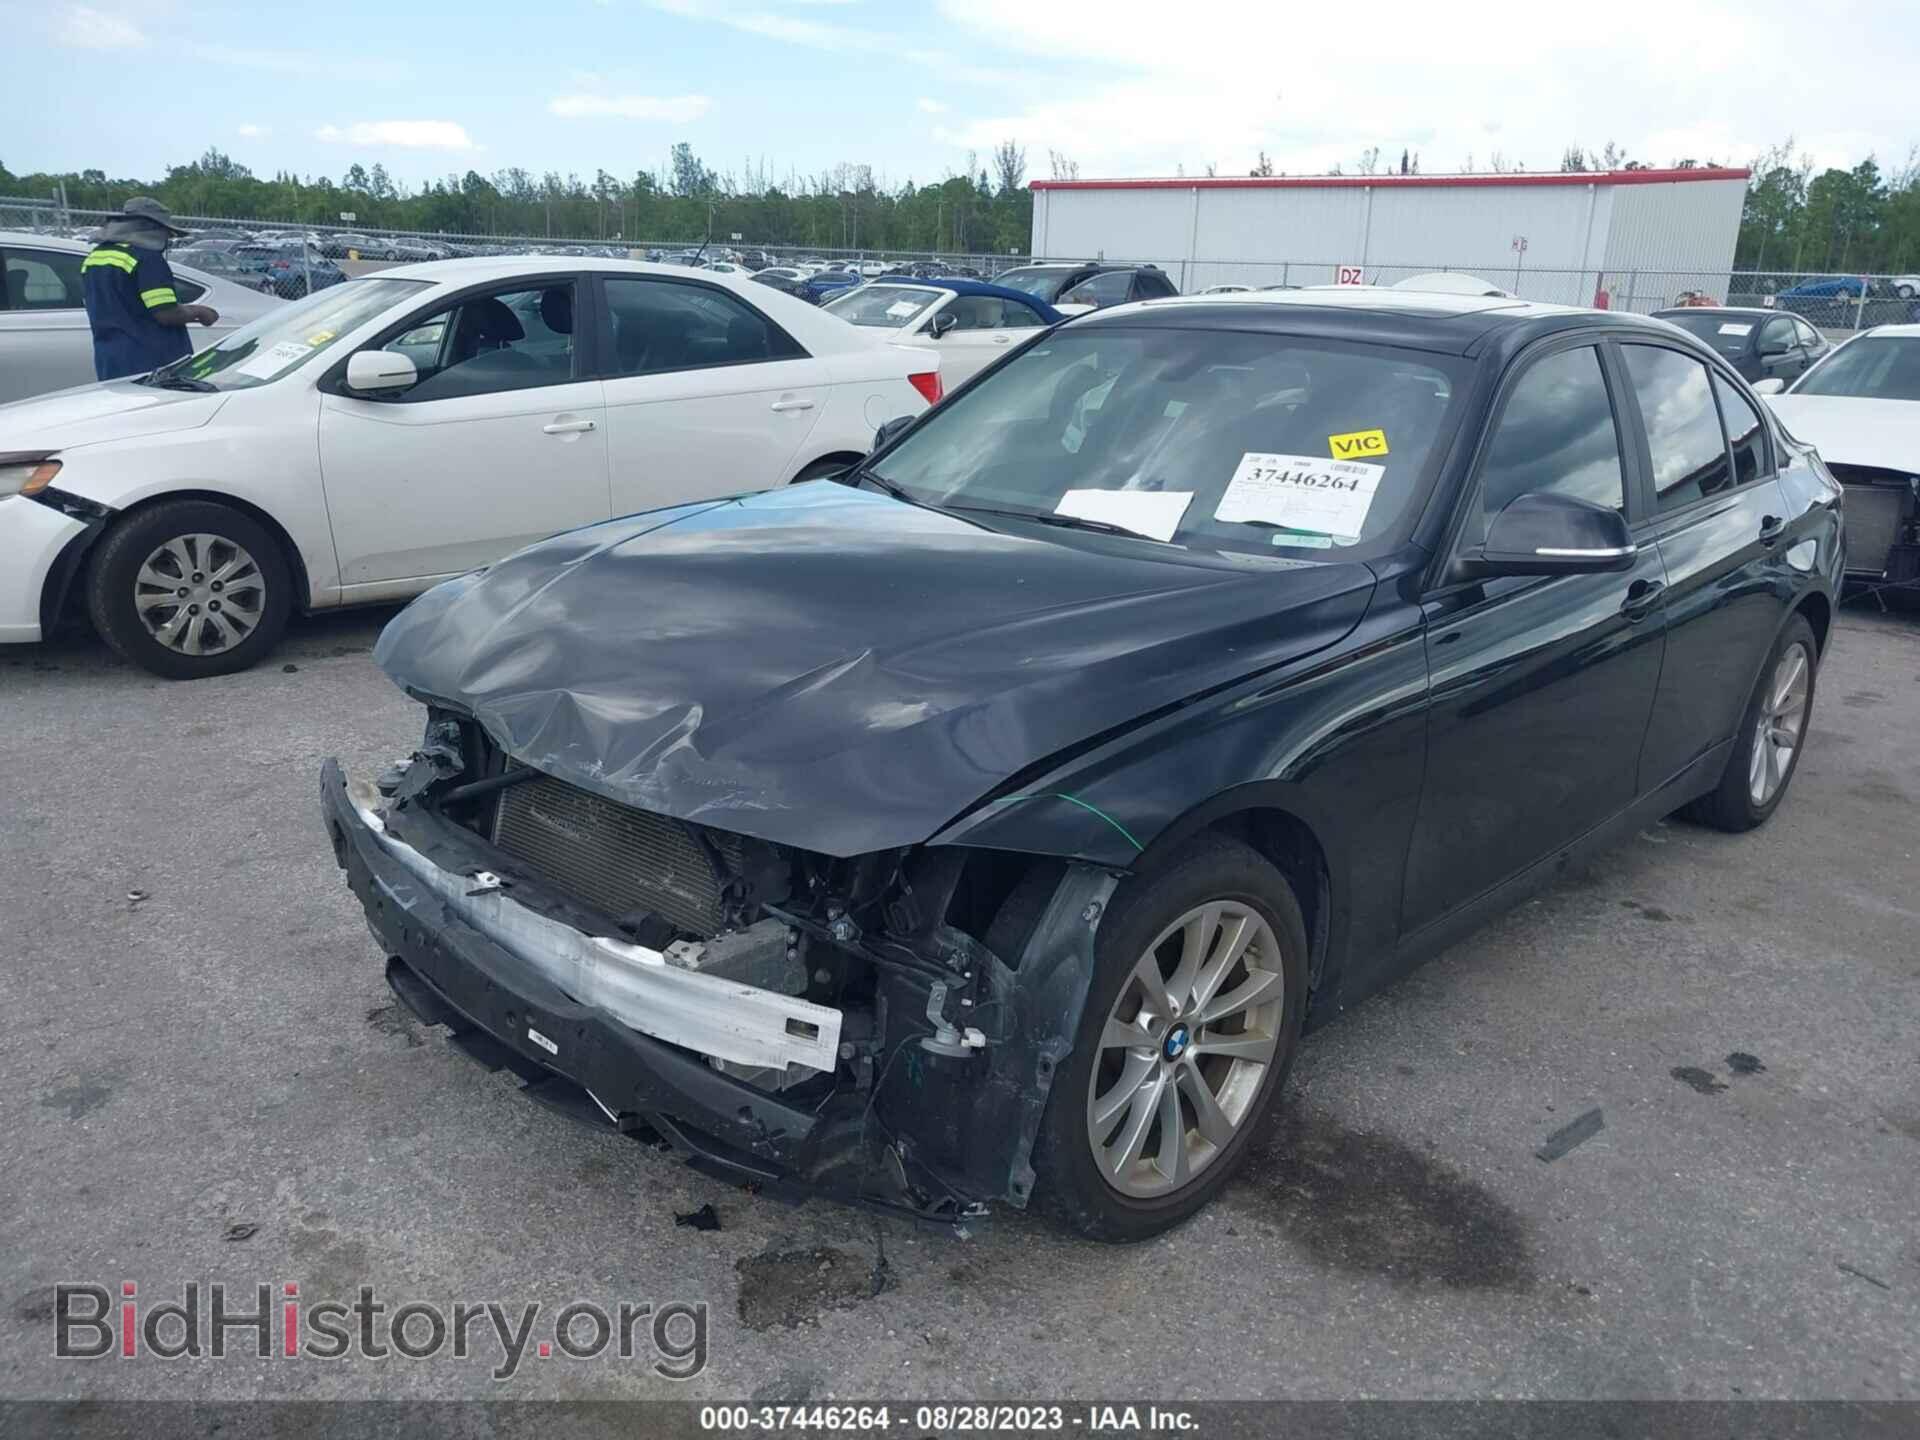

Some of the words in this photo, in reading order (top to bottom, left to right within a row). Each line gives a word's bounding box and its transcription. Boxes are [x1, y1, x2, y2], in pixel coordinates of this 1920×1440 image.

[1340, 268, 1362, 286] DZ
[1334, 435, 1382, 454] VIC
[1247, 467, 1360, 492] 37446264
